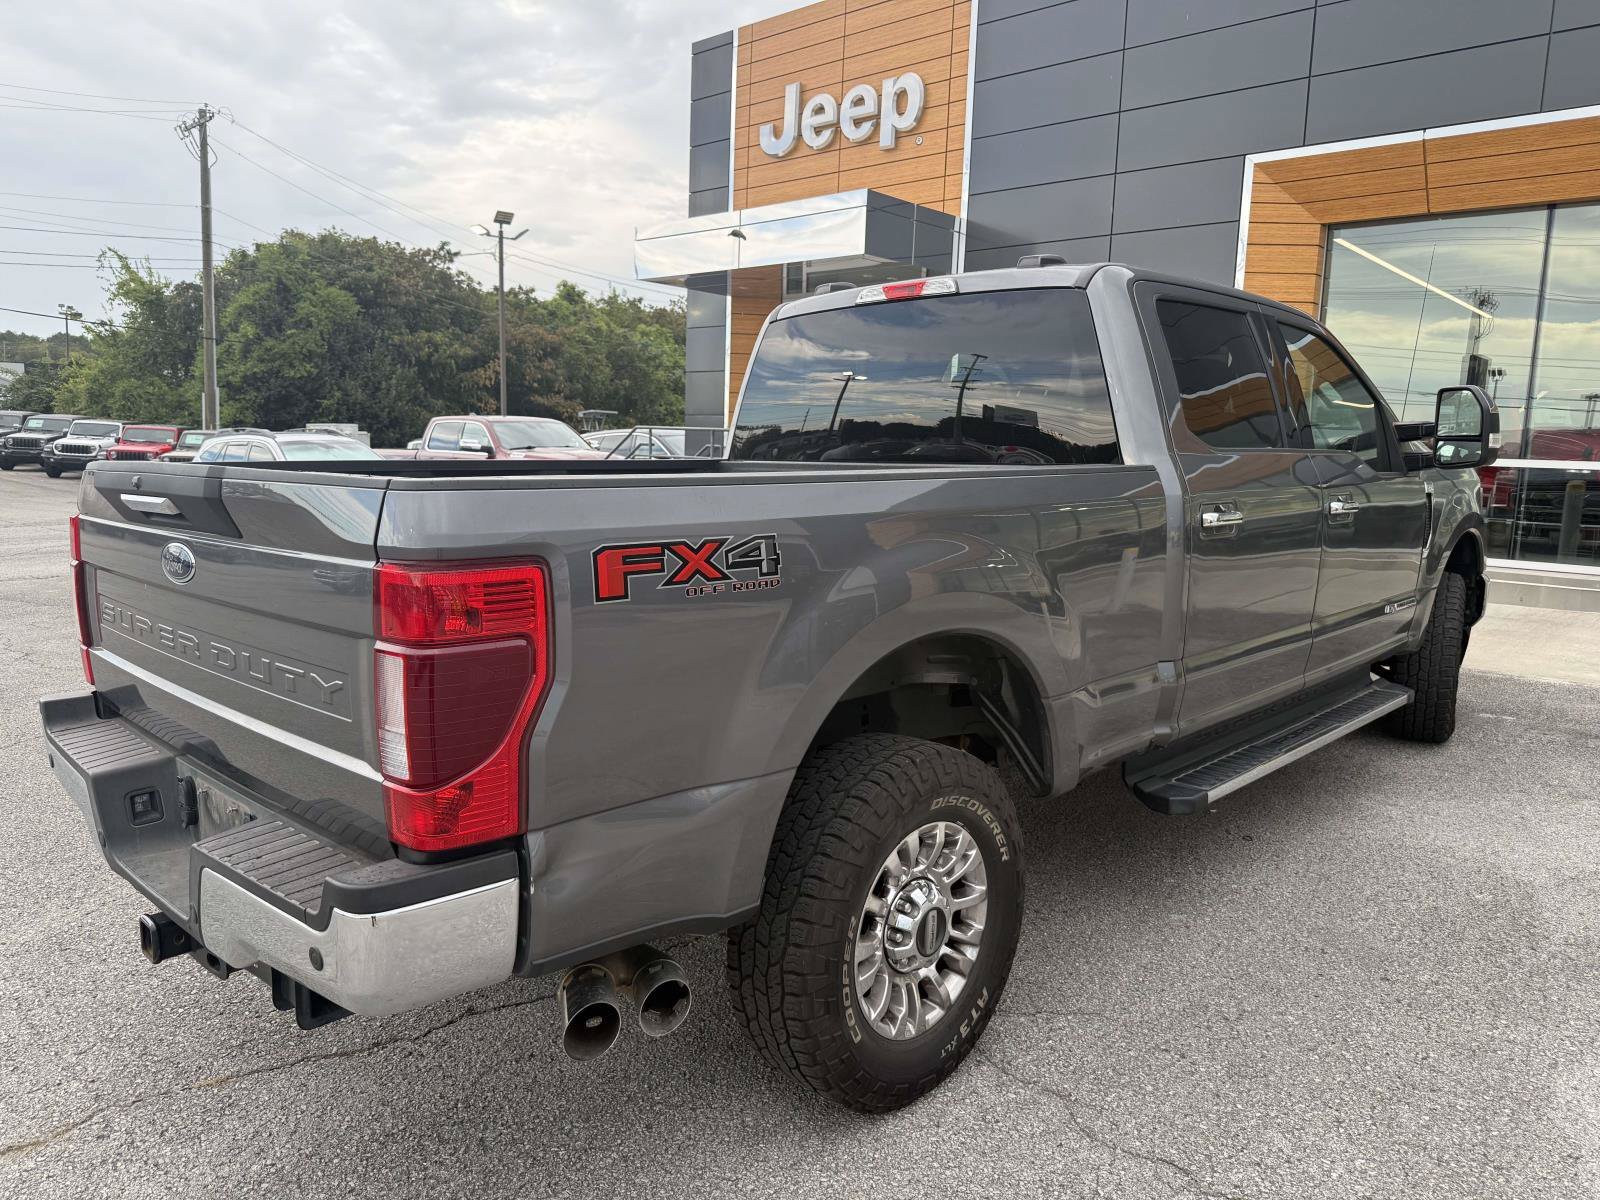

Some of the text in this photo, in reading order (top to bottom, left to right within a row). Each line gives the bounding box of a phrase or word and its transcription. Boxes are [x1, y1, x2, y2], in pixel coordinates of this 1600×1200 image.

[759, 72, 925, 157] Jeep
[590, 533, 782, 604] FX4
[685, 577, 782, 598] OFF ROAD
[102, 601, 344, 706] SUPER DUTY
[929, 795, 1010, 862] DISCOVERER
[842, 915, 862, 1044] COOPER
[960, 986, 989, 1038] AT3
